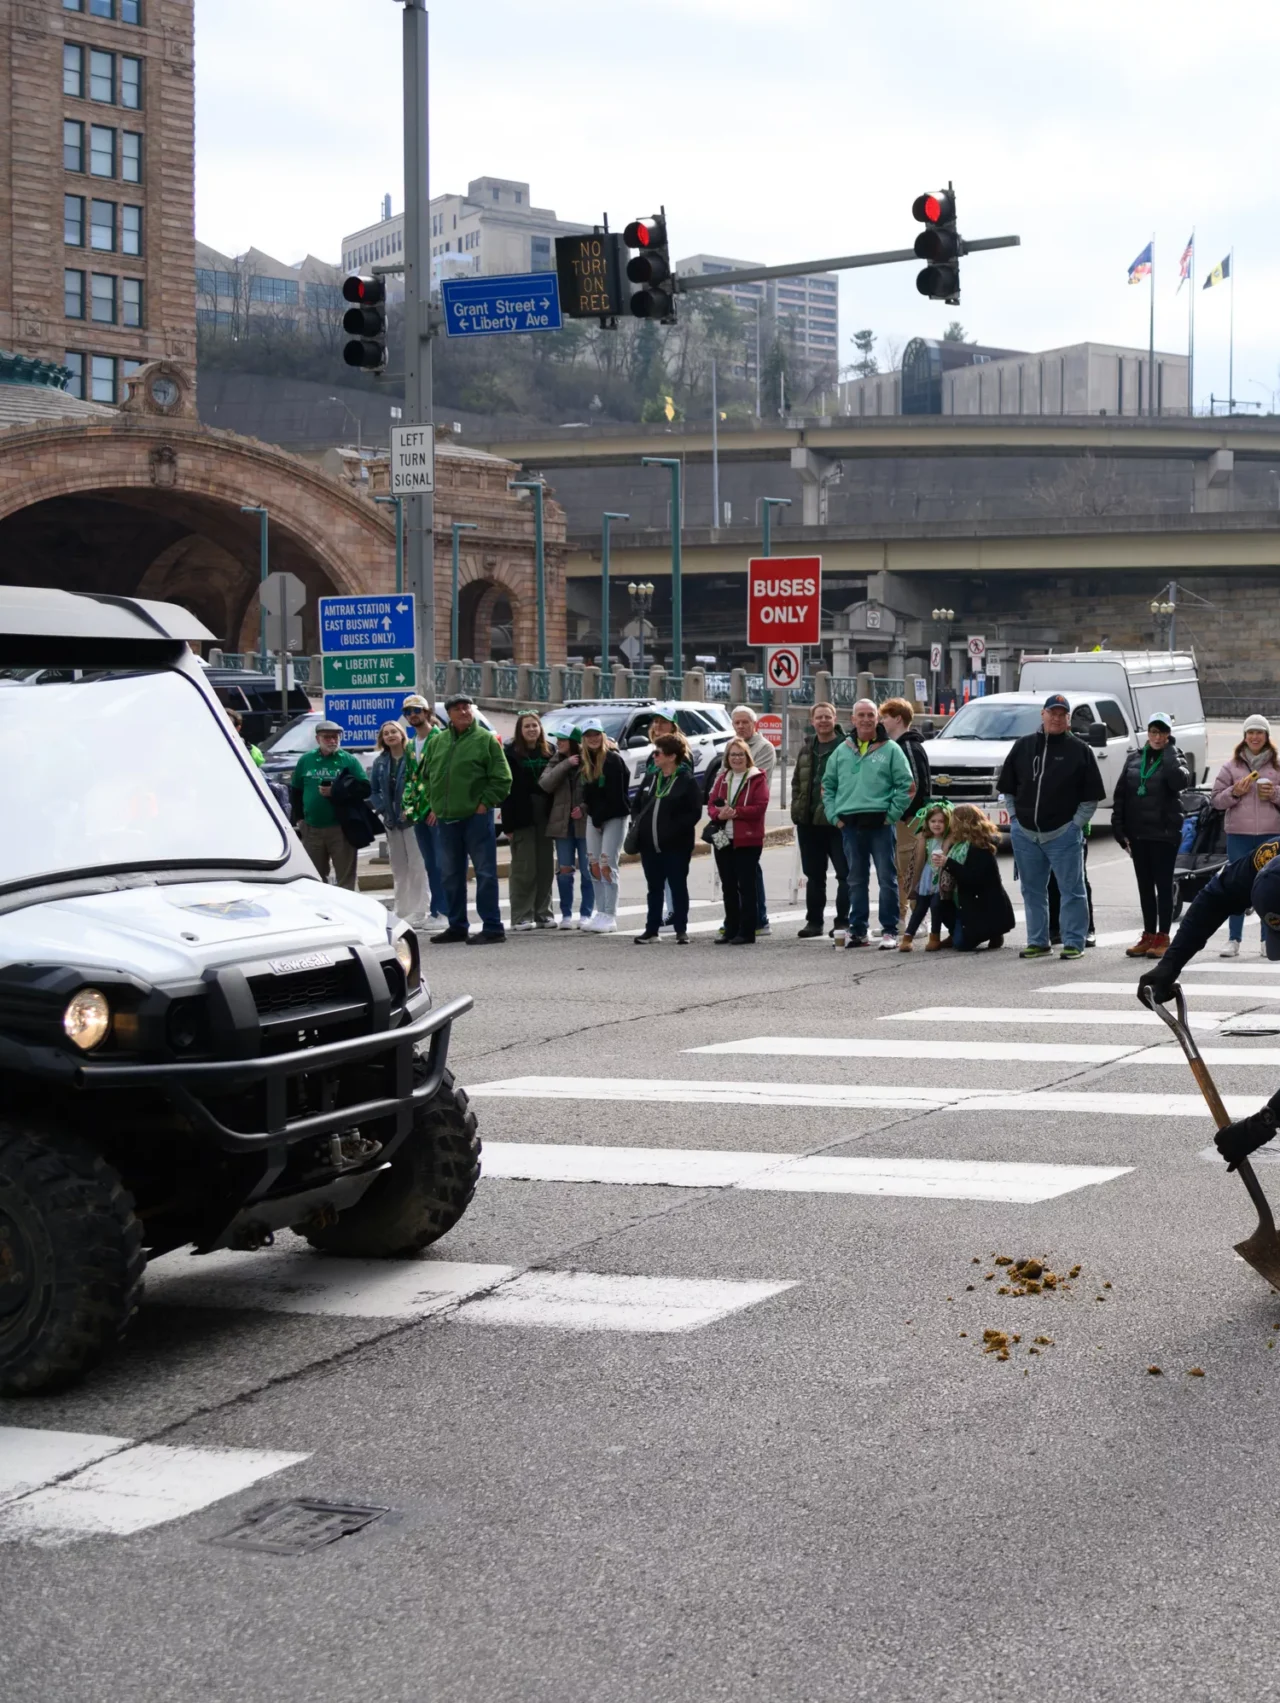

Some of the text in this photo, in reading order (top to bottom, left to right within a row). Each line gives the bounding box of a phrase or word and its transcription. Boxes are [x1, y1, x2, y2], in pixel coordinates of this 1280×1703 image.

[580, 240, 601, 258] NO
[583, 276, 604, 293] ON
[453, 298, 536, 317] Grant Street
[472, 313, 549, 331] Liberty Ave
[400, 432, 424, 447] LEFT
[399, 453, 426, 467] TURN
[394, 472, 432, 487] SIGNAL
[753, 578, 816, 597] BUSES
[324, 603, 391, 617] AMTRAK STATION
[760, 605, 809, 624] ONLY
[324, 618, 379, 631] EAST BUSWAY
[340, 632, 396, 646] (BUSES ONLY)
[345, 657, 395, 670] LIBERTY AVE
[351, 673, 389, 686] GRANT ST
[328, 698, 395, 711] PORT AUTHORITY
[347, 714, 377, 726] POLICE
[339, 730, 379, 742] EPARTME
[268, 952, 334, 975] Kawasaki
